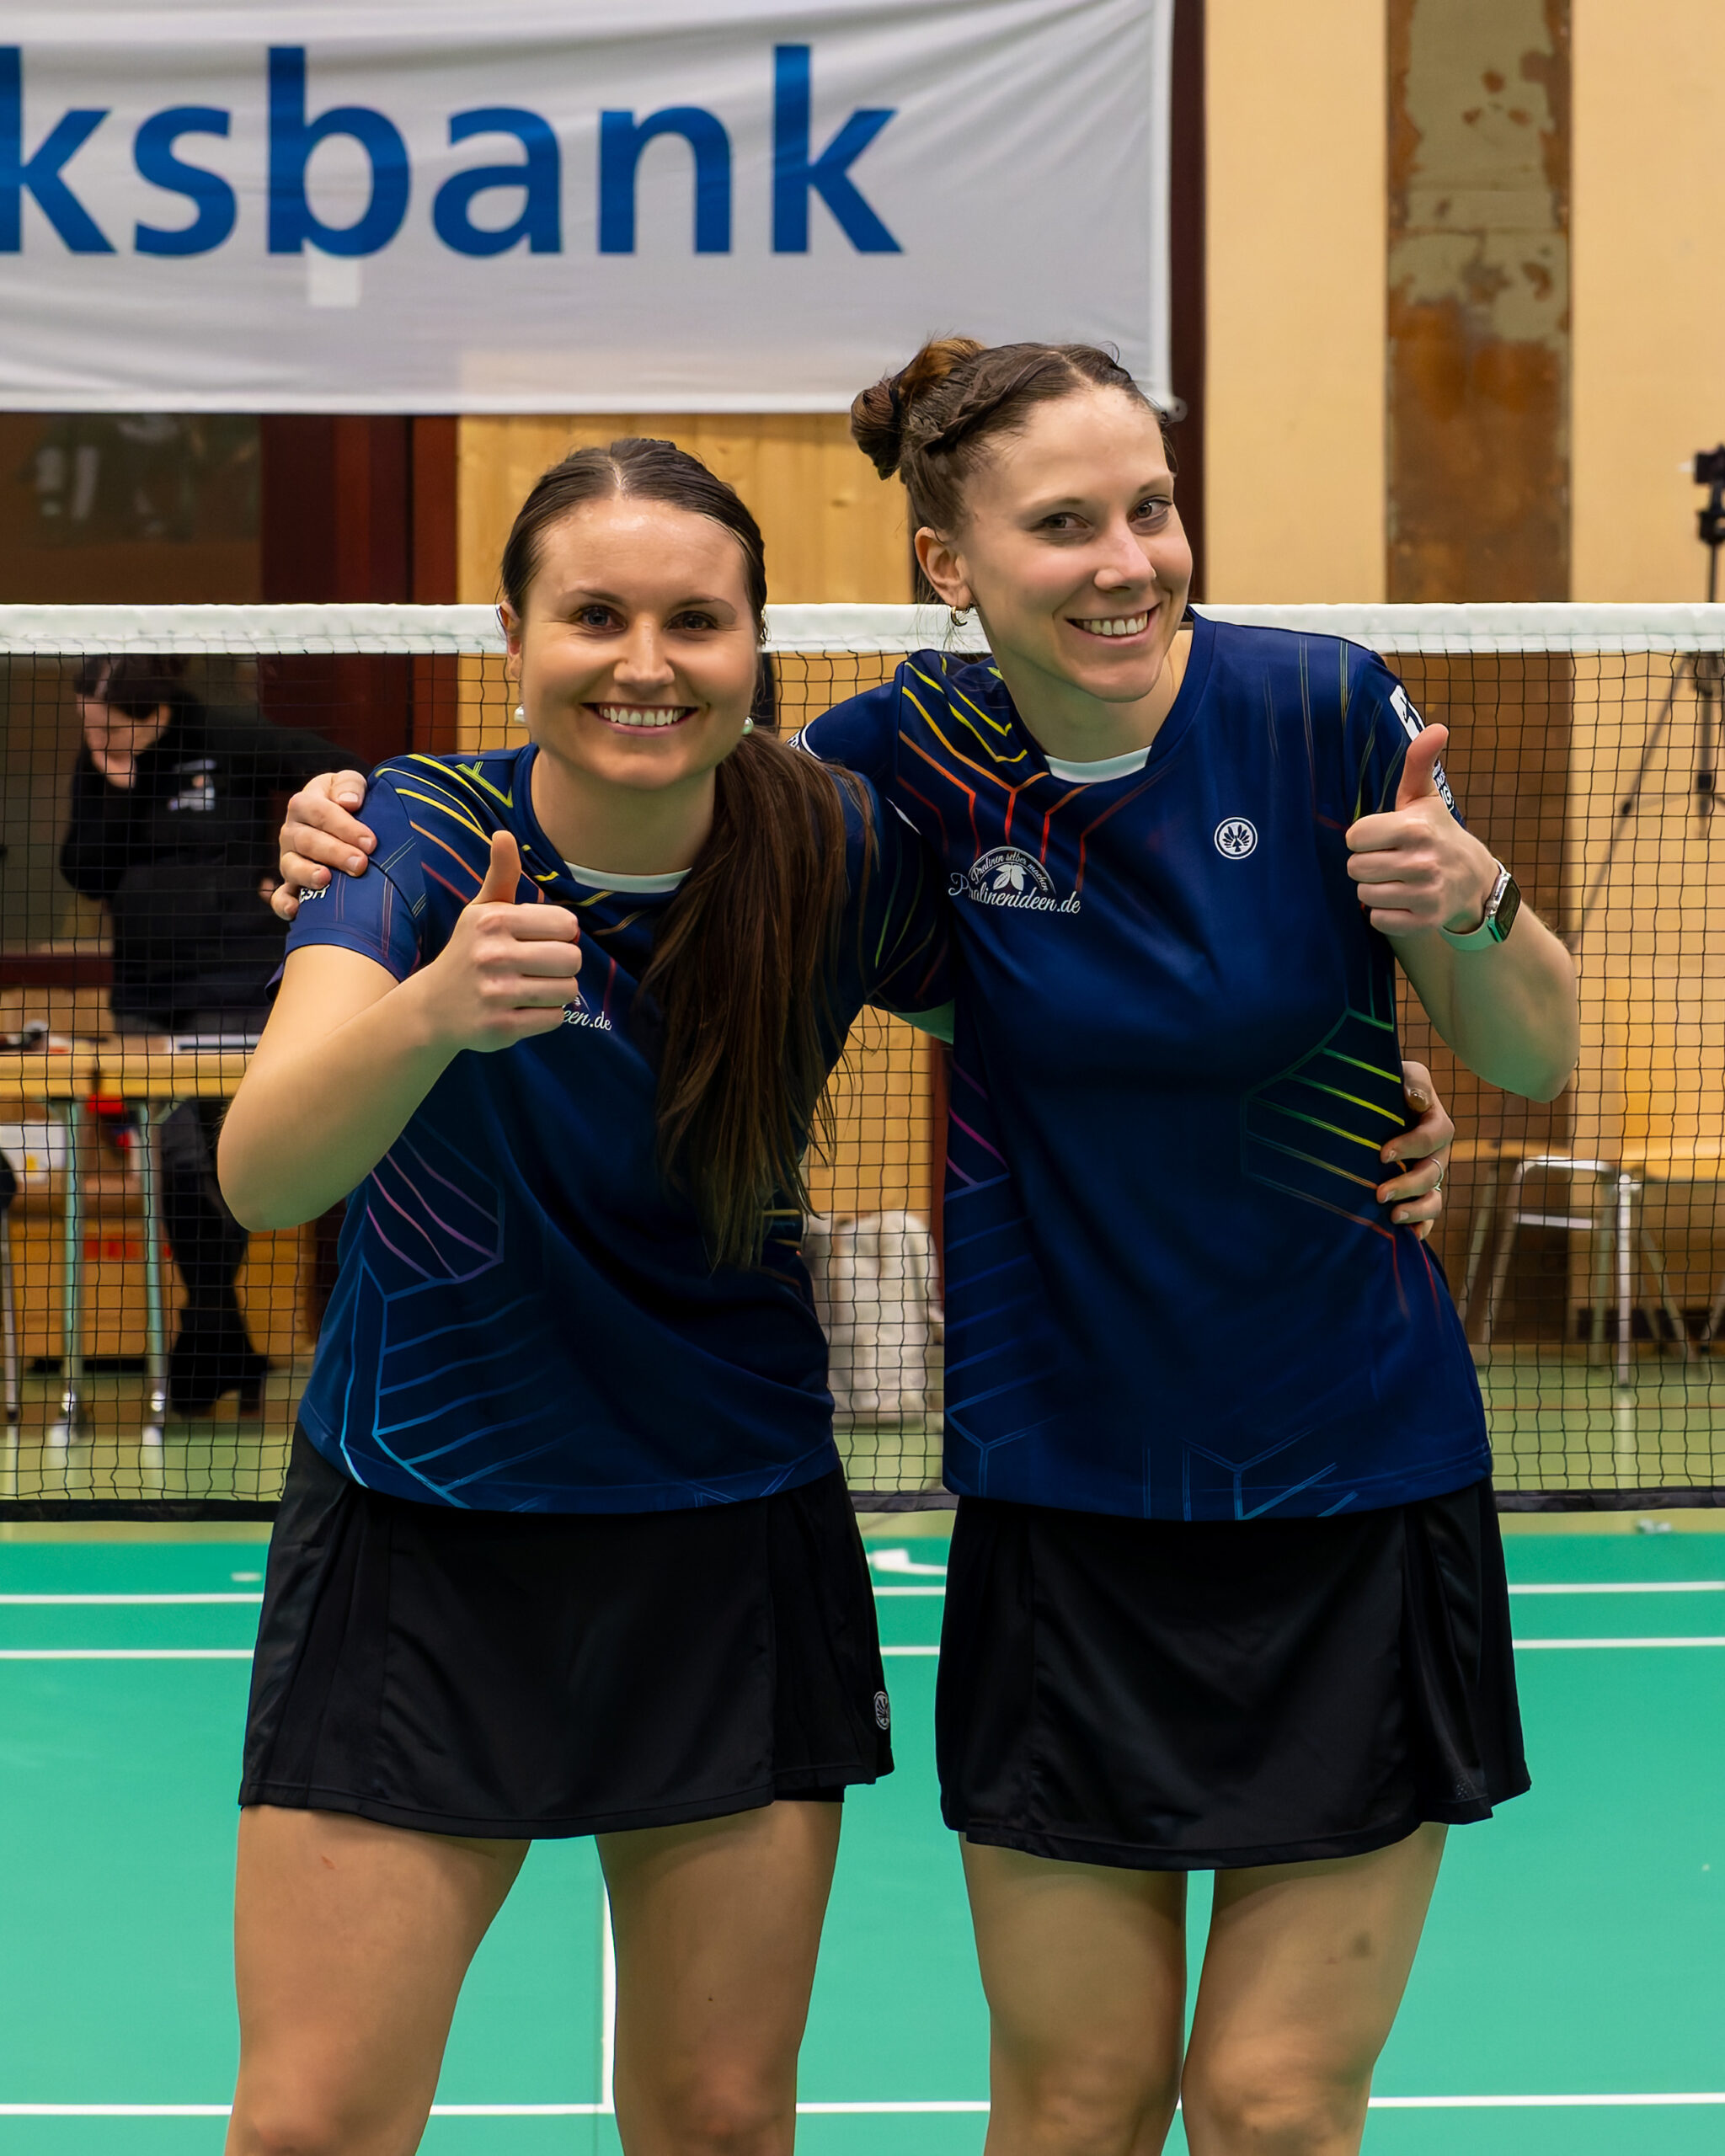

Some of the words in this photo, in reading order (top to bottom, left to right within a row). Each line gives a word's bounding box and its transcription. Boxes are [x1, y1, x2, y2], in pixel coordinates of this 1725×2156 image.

[0, 44, 904, 258] ksbank
[971, 855, 1004, 884] Pralinen
[948, 873, 1080, 914] Pralinenideen.de
[563, 1006, 612, 1030] een.de
